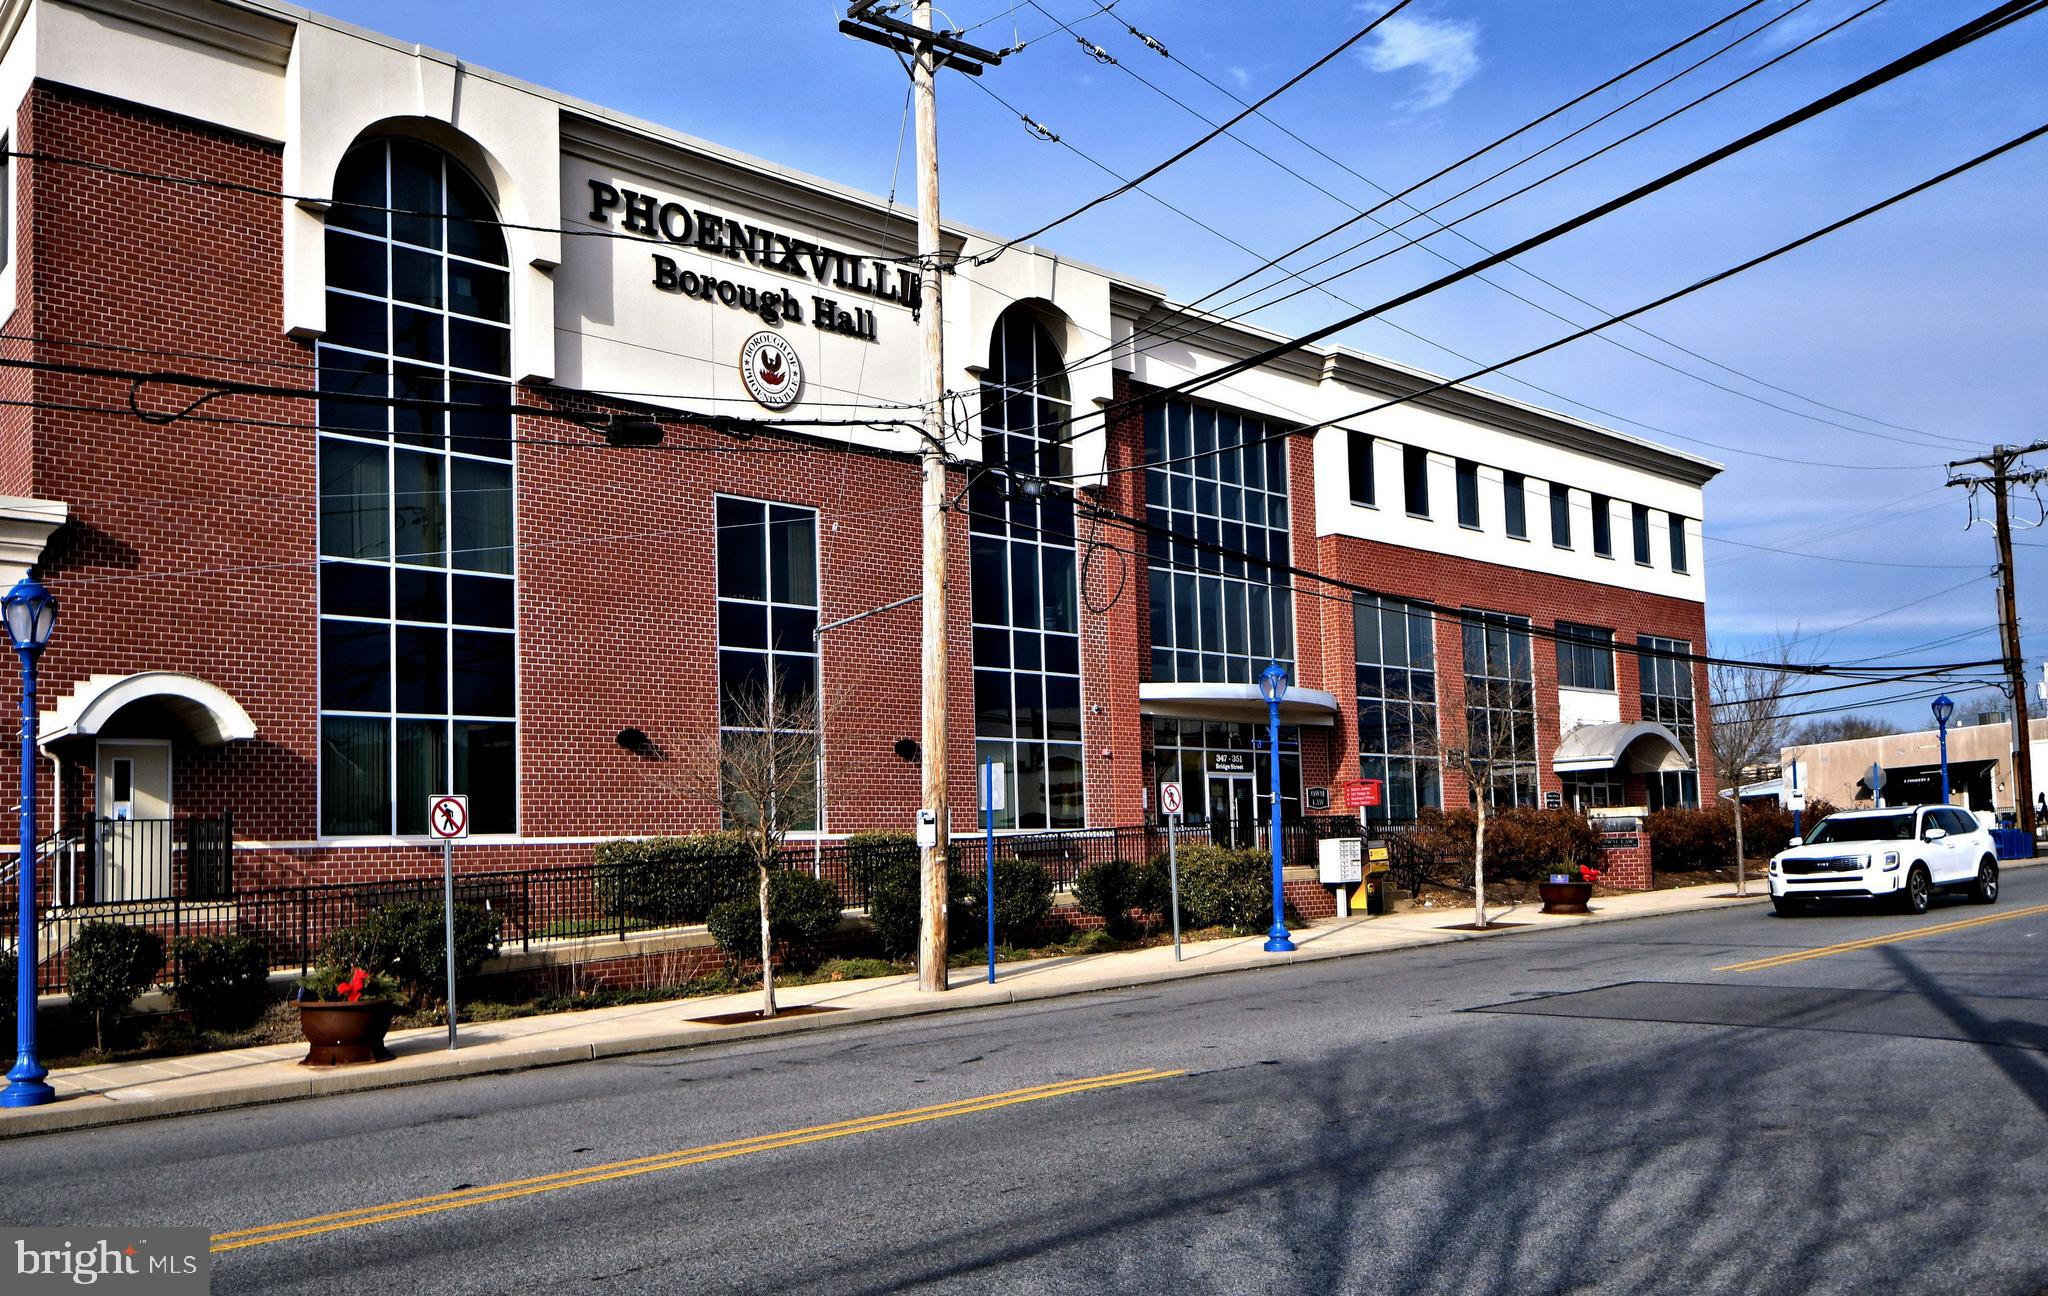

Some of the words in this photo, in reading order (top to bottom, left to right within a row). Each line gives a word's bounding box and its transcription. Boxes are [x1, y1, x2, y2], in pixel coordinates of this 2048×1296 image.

[652, 253, 802, 325] Borough
[811, 296, 876, 342] Hall
[745, 334, 788, 358] BOROUGH
[786, 351, 798, 367] OF
[1215, 754, 1228, 762] 347
[1231, 754, 1243, 763] 351
[1215, 762, 1230, 770] Bridge
